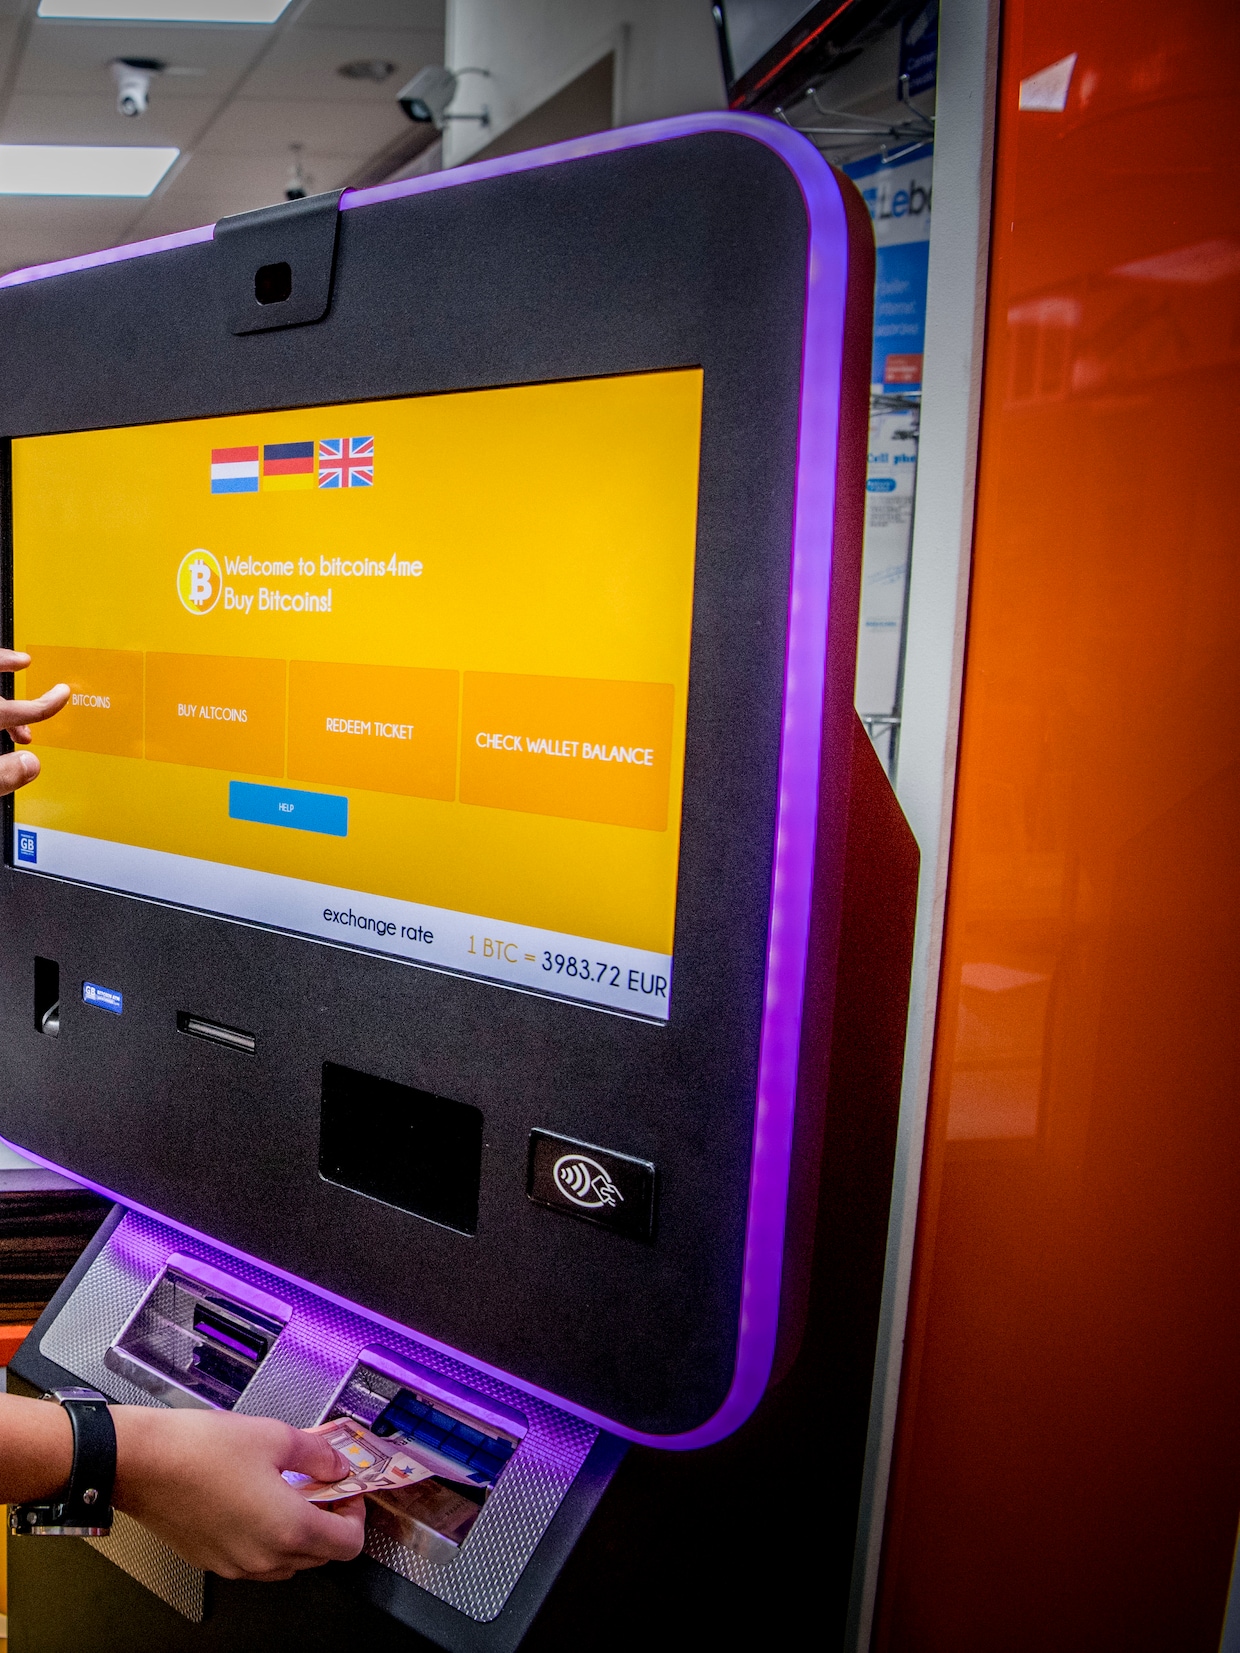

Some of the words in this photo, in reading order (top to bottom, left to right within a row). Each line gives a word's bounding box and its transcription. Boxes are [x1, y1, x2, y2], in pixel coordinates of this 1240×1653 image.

[224, 555, 294, 576] Welcome
[298, 556, 315, 576] to
[319, 552, 423, 577] bitcoins4me
[224, 587, 254, 614] Buy
[258, 587, 333, 612] Bitcoins!
[72, 693, 110, 709] BITCOINS
[177, 703, 197, 717] BUY
[198, 705, 248, 723] ALTCOINS
[325, 717, 371, 735] REDEEM
[373, 722, 414, 740] TICKET
[475, 732, 523, 752] CHECK
[526, 737, 579, 758] WALLET
[582, 743, 654, 766] BALANCE
[278, 802, 294, 813] HELP
[20, 837, 35, 851] GB
[322, 907, 397, 937] exchange
[401, 925, 434, 944] rate
[467, 935, 477, 955] 1
[483, 938, 519, 964] BTC
[541, 951, 621, 987] 3983.72
[627, 970, 668, 998] EUR
[85, 985, 96, 996] GB
